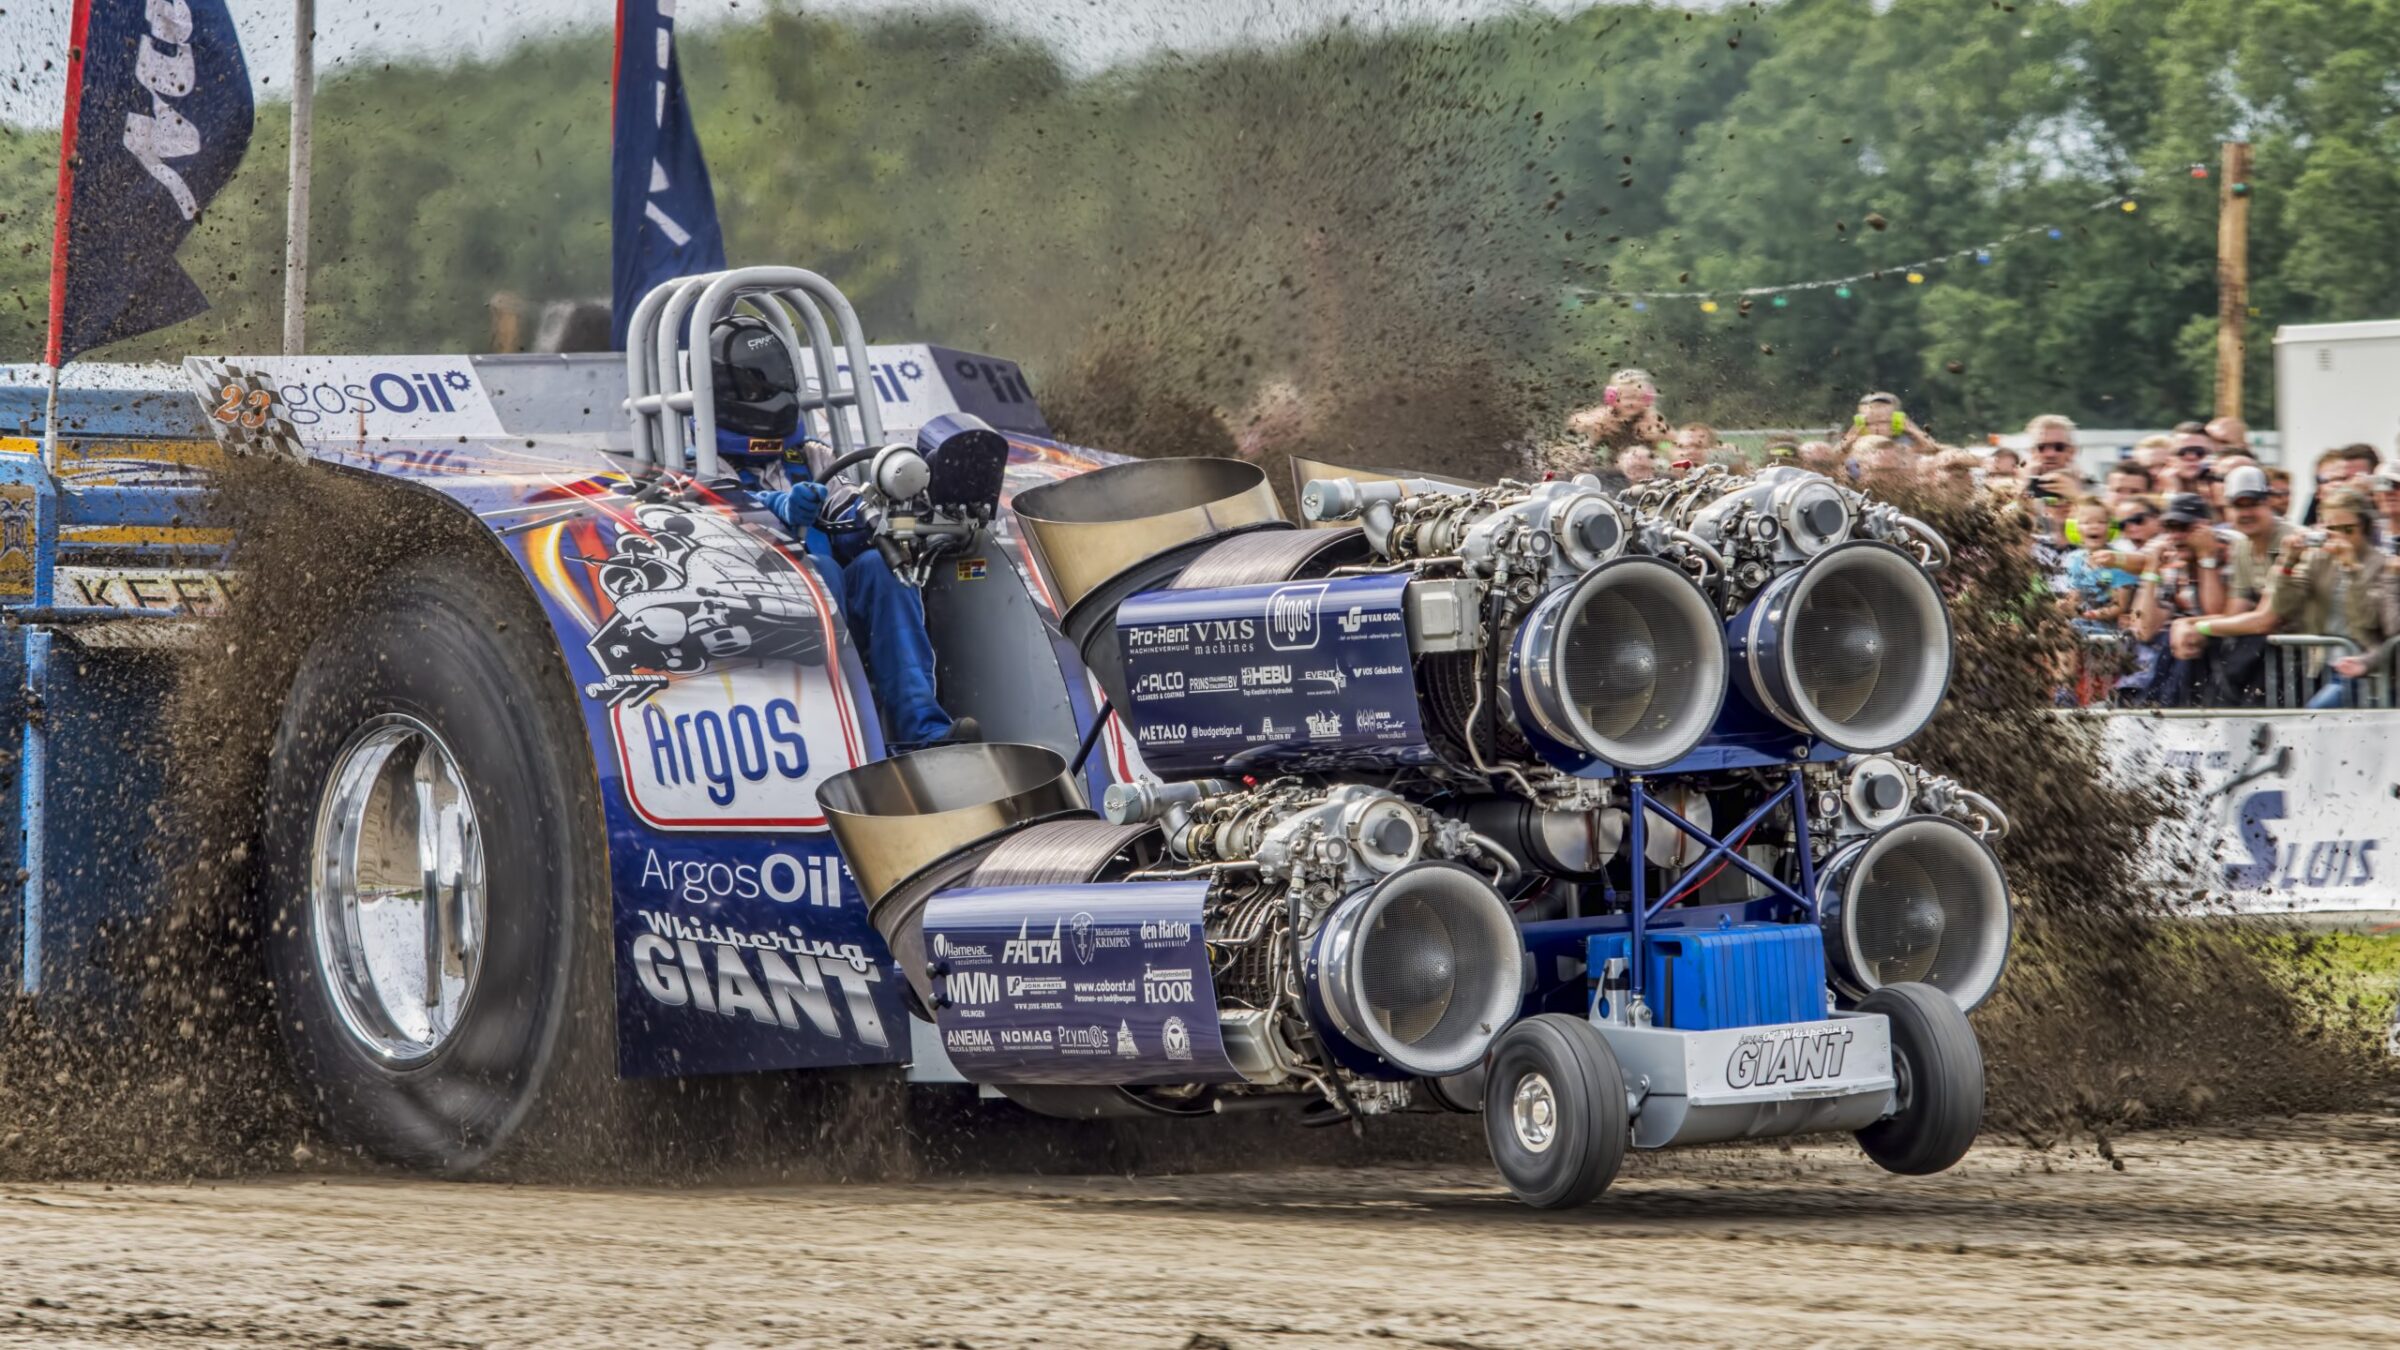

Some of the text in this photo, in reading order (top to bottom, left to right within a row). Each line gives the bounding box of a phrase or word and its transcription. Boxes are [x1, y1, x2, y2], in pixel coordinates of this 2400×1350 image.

[212, 383, 272, 429] 23
[1274, 594, 1312, 642] Argos
[1368, 612, 1401, 623] VAN GOOL
[1129, 623, 1190, 646] Pro-Rent
[1193, 619, 1255, 642] VMS
[1195, 641, 1255, 655] machines
[1189, 677, 1209, 690] PRINS
[1305, 670, 1335, 679] EVENT
[1139, 724, 1187, 741] METALO
[641, 697, 810, 806] Argos
[638, 909, 874, 968] Whispering
[1001, 916, 1062, 964] FACTA
[1140, 919, 1191, 942] den Hartog
[947, 942, 987, 956] Hamevac
[1095, 937, 1131, 948] KRIMPEN
[632, 933, 889, 1048] GIANT
[946, 972, 999, 1004] MVM
[1074, 980, 1136, 992] www.coborst.nl
[1144, 982, 1195, 1004] FLOOR
[960, 1009, 985, 1018] VEILINGEN
[947, 1029, 994, 1046] ANEMA
[1000, 1030, 1052, 1043] NOMAG
[1727, 1031, 1854, 1090] GIANT
